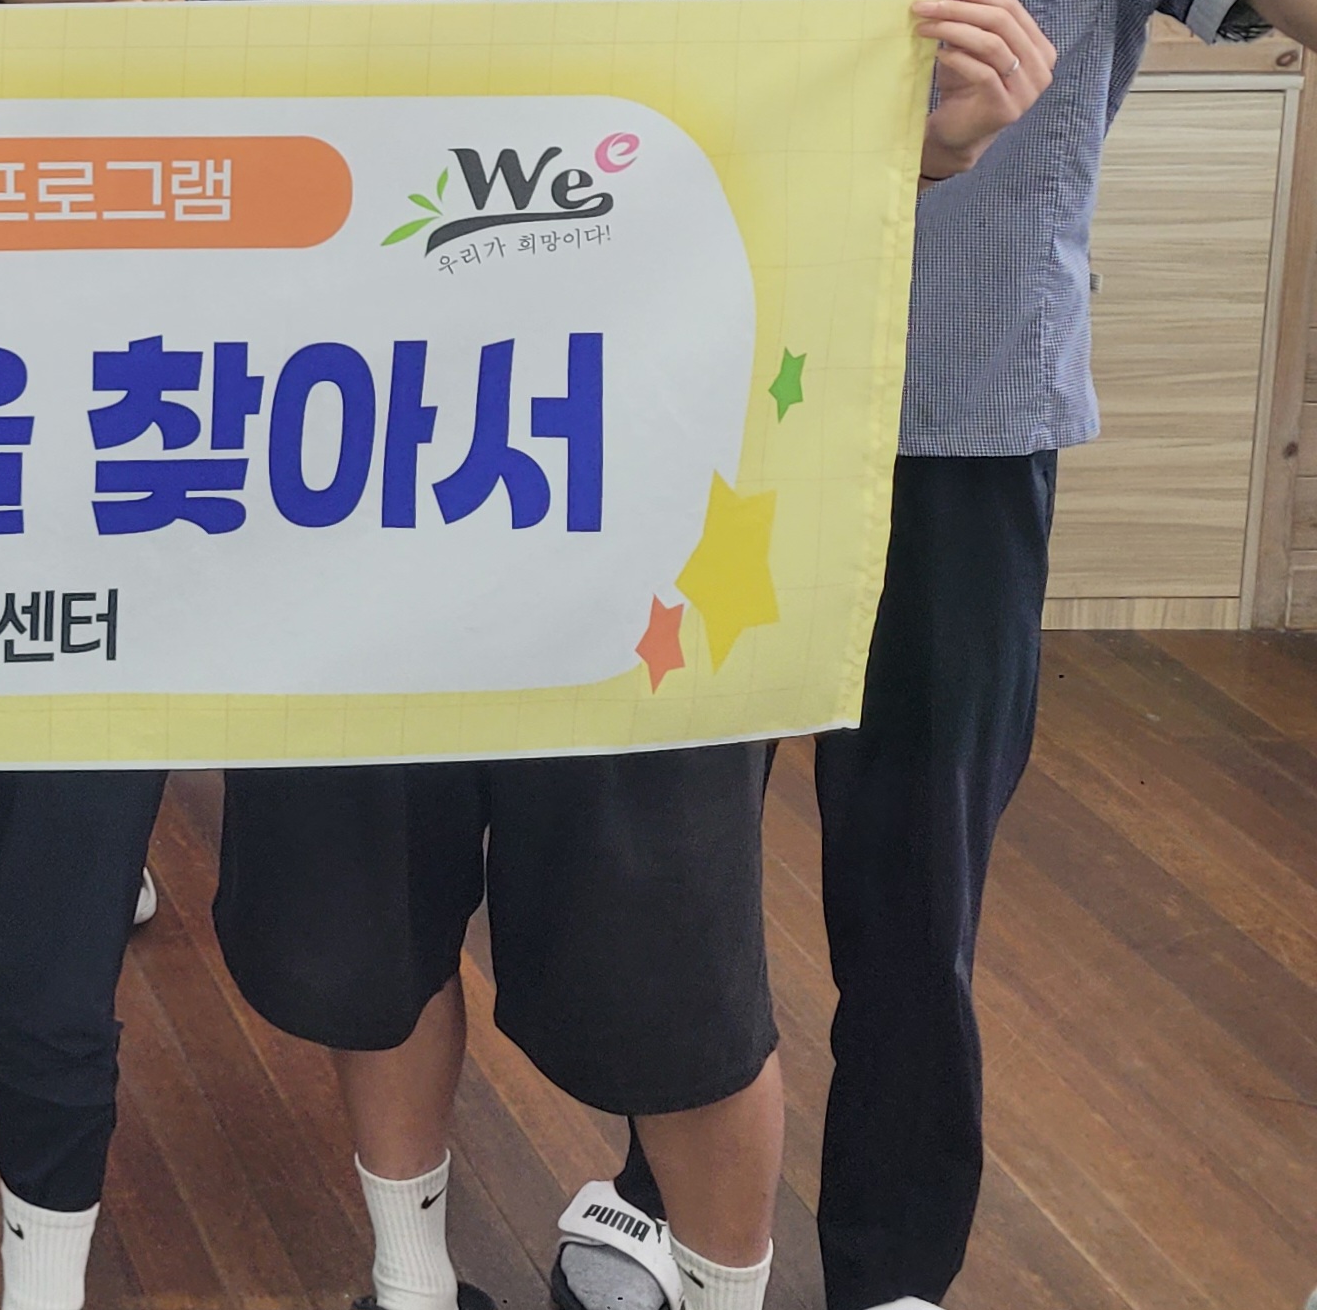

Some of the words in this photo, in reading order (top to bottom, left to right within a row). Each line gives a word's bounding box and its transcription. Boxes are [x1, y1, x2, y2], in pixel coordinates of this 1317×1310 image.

[437, 236, 506, 275] 우리가
[517, 224, 612, 254] 희망이다!
[87, 332, 604, 536] 찾아서
[582, 1203, 652, 1243] PUMA
